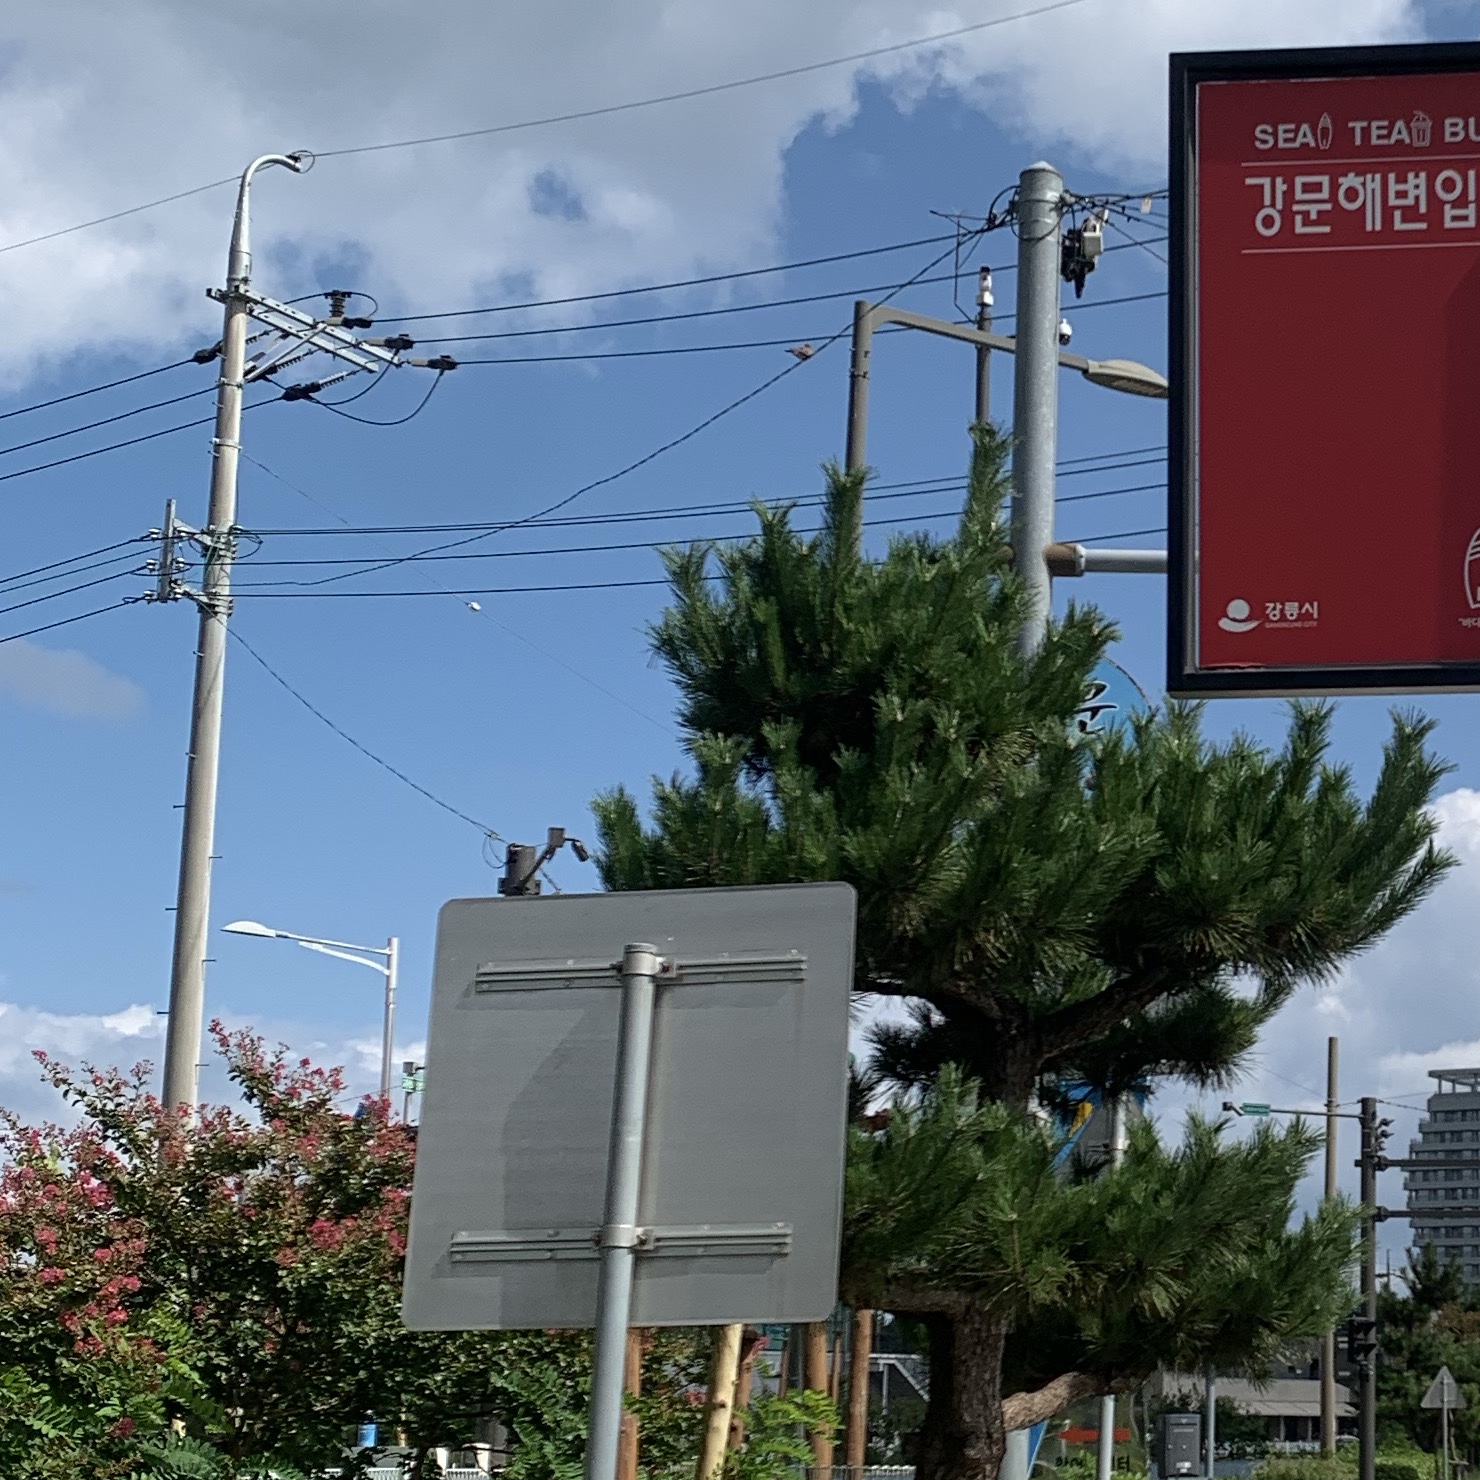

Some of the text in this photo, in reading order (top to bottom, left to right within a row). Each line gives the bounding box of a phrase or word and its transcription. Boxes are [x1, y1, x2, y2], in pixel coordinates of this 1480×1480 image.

[1254, 123, 1316, 149] SEA
[1348, 120, 1411, 146] TEA
[1265, 601, 1318, 620] 강릉시
